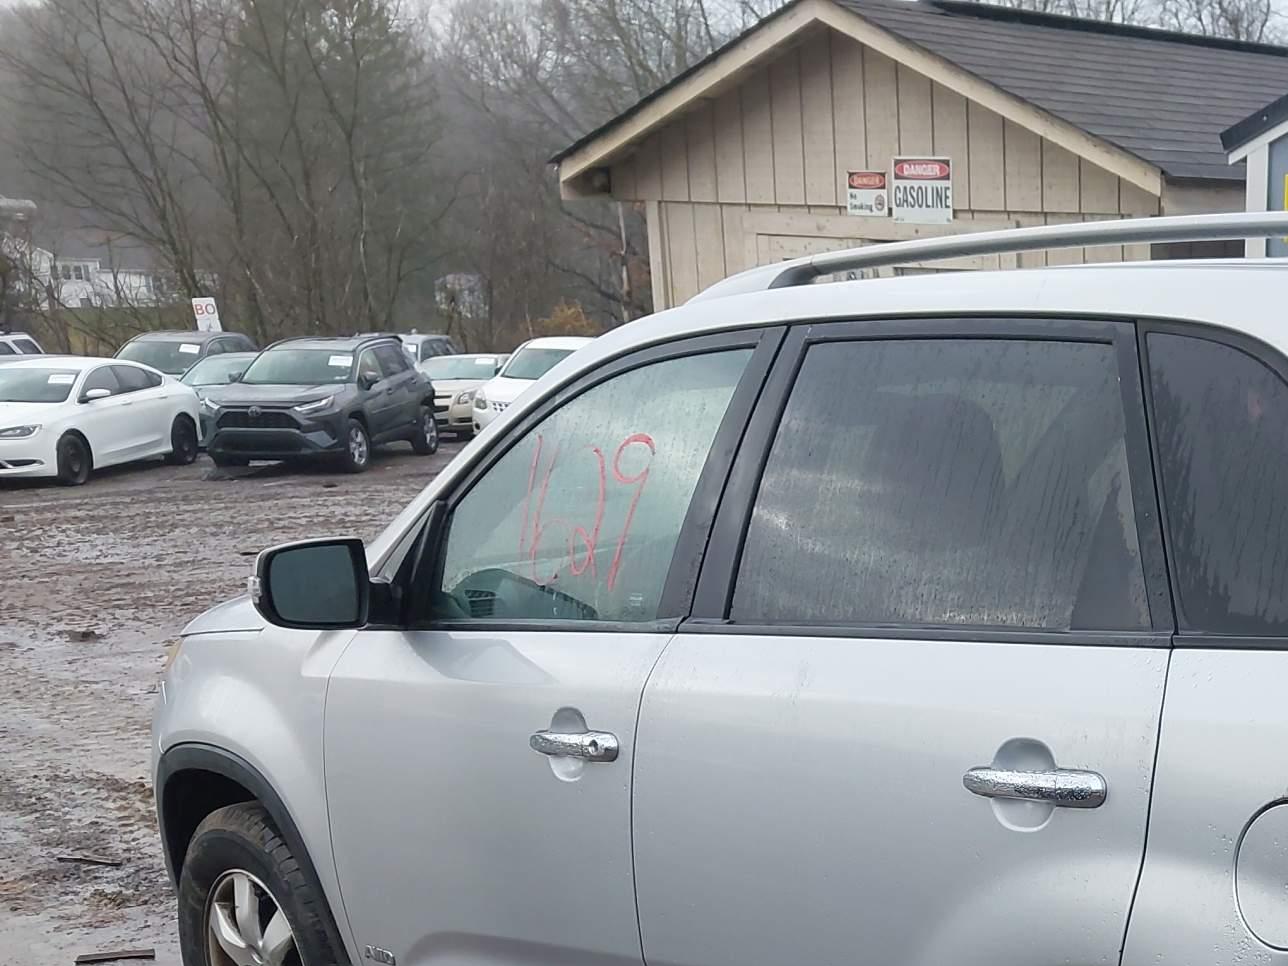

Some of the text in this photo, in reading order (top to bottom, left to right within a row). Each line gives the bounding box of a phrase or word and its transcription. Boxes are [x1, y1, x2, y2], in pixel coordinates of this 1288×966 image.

[903, 164, 940, 176] DANGER
[894, 185, 951, 208] GASOLINE
[518, 432, 656, 593] 1629
